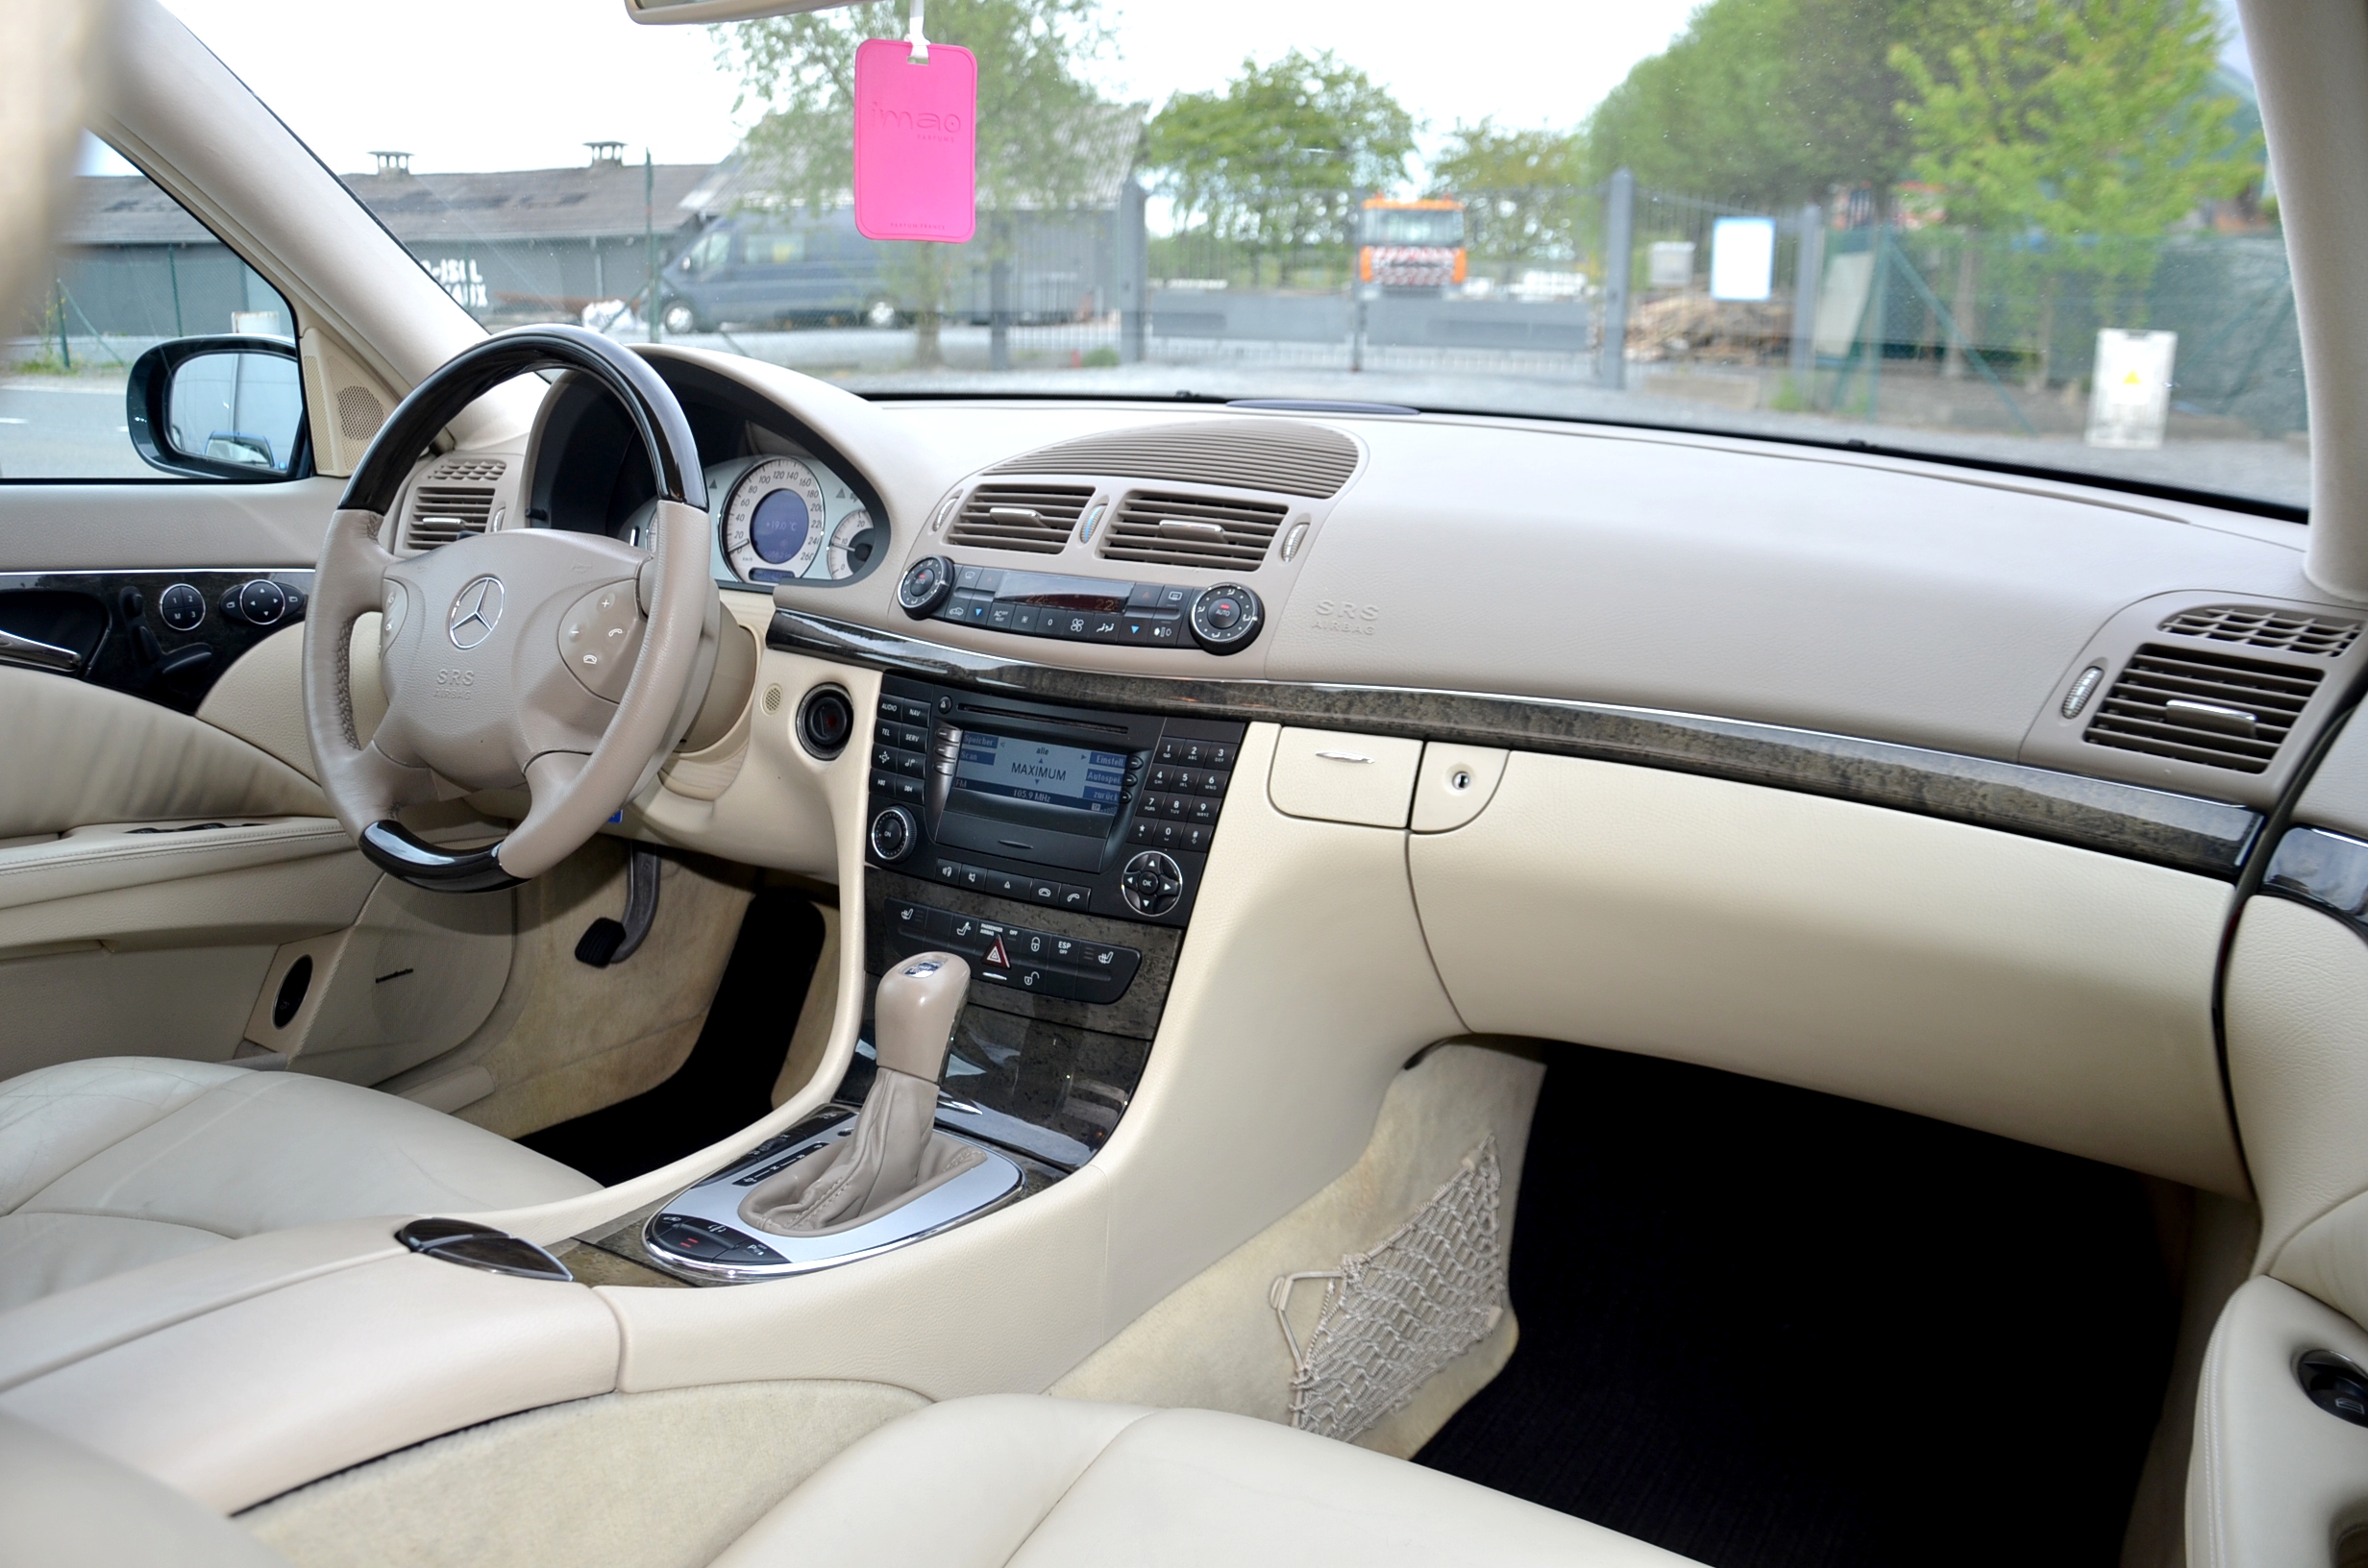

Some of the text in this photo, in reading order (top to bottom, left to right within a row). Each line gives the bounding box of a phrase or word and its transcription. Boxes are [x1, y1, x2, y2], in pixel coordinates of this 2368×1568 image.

[872, 101, 961, 133] imao
[917, 134, 954, 143] PARFUMS
[773, 471, 785, 479] 120
[786, 472, 799, 480] 140
[758, 476, 771, 484] 100
[799, 478, 812, 487] 160
[748, 485, 758, 494] 80
[806, 490, 819, 499] 180
[740, 499, 750, 507] 60
[735, 513, 745, 522] 40
[734, 530, 744, 539] 20
[1215, 608, 1231, 617] AUTO
[1315, 599, 1380, 622] SRS
[1311, 620, 1375, 636] AIRBAG
[437, 669, 475, 686] SRS
[881, 702, 898, 712] AUDIO
[909, 708, 921, 717] NAV
[881, 727, 891, 737] TEL
[905, 733, 920, 743] SERV
[964, 734, 994, 747] Speicher
[961, 750, 977, 761] Scan
[1036, 747, 1049, 756] alle
[1192, 747, 1197, 755] 2
[1218, 748, 1224, 757] 3
[1011, 762, 1067, 782] MAXIMUM
[1156, 771, 1163, 779] 4
[1182, 773, 1188, 782] 5
[955, 778, 967, 788] FM
[1013, 789, 1051, 803] 105.9 MHz
[1094, 790, 1119, 802] zurück
[1148, 797, 1155, 806] 7
[1173, 800, 1180, 809] 8
[1200, 803, 1207, 812] 9
[1165, 827, 1172, 836] 0
[980, 923, 1003, 933] PASSENGER
[1058, 941, 1072, 949] ESP
